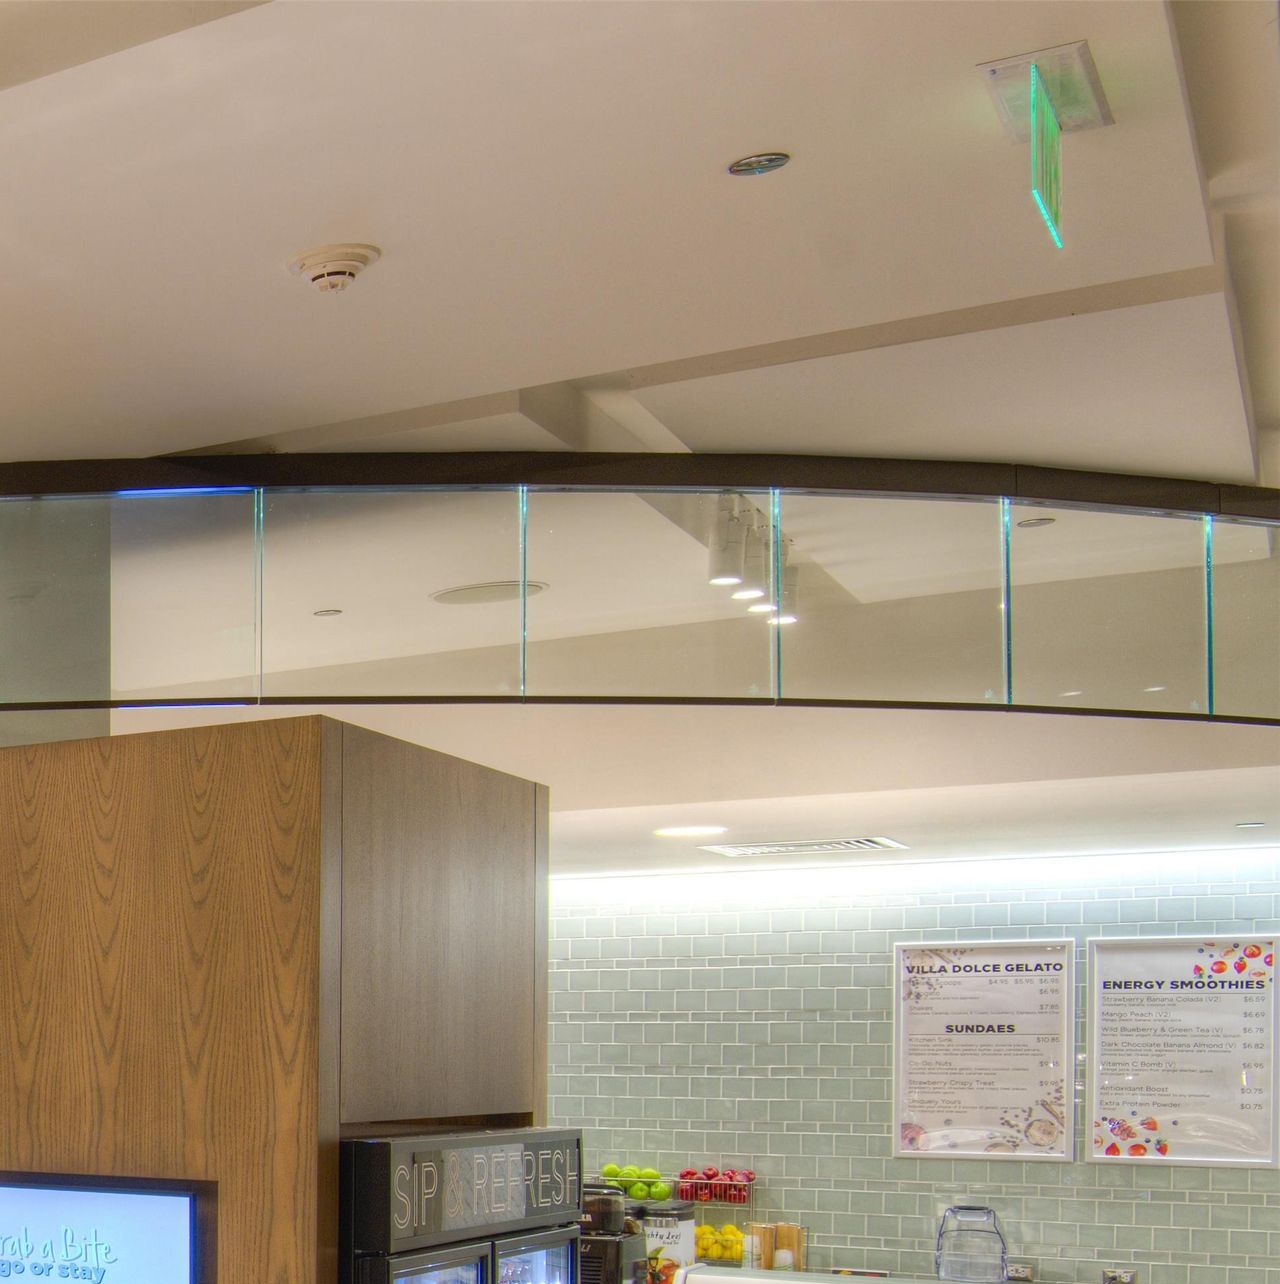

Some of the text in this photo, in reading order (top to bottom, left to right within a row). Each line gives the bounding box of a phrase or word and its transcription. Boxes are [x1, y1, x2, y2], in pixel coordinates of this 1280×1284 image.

[906, 963, 1063, 974] VILLA DOLCE GELATO
[1102, 980, 1265, 990] ENERGY SMOOTHIES
[945, 1024, 1016, 1034] SUNDAES
[1120, 1026, 1158, 1034] Blueberry
[393, 1148, 580, 1229] SIP & REFRESH
[42, 1236, 54, 1260] a
[58, 1224, 118, 1268] Bite
[31, 1262, 54, 1277] or
[58, 1264, 106, 1284] stay
